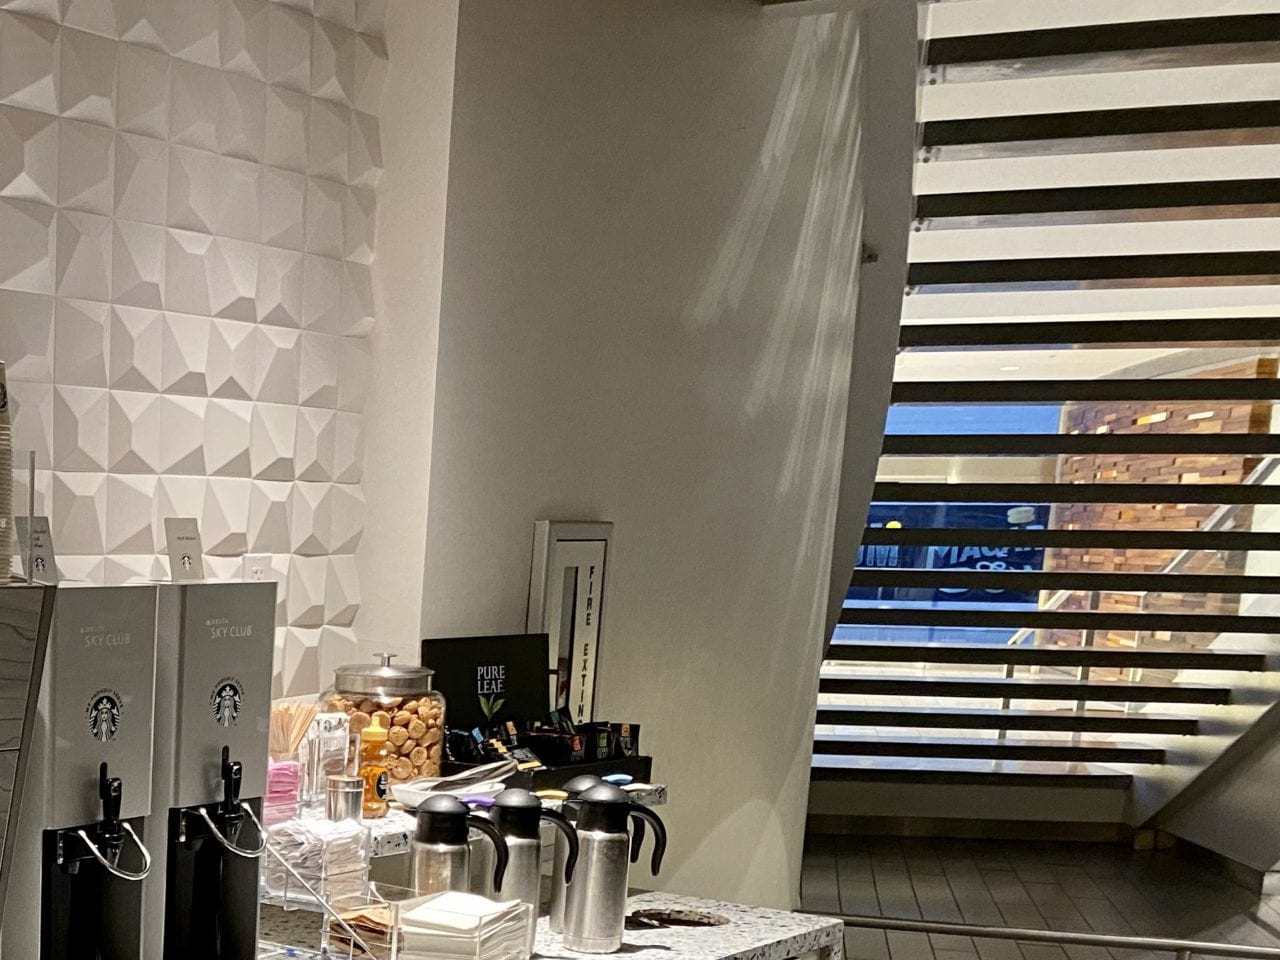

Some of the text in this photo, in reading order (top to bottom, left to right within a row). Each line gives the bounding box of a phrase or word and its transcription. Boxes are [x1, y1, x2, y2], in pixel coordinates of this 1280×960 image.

[585, 565, 595, 626] FIRE
[229, 624, 252, 637] CLUB
[105, 632, 131, 646] CLUB
[477, 665, 505, 680] PURE
[477, 679, 505, 694] LEAF
